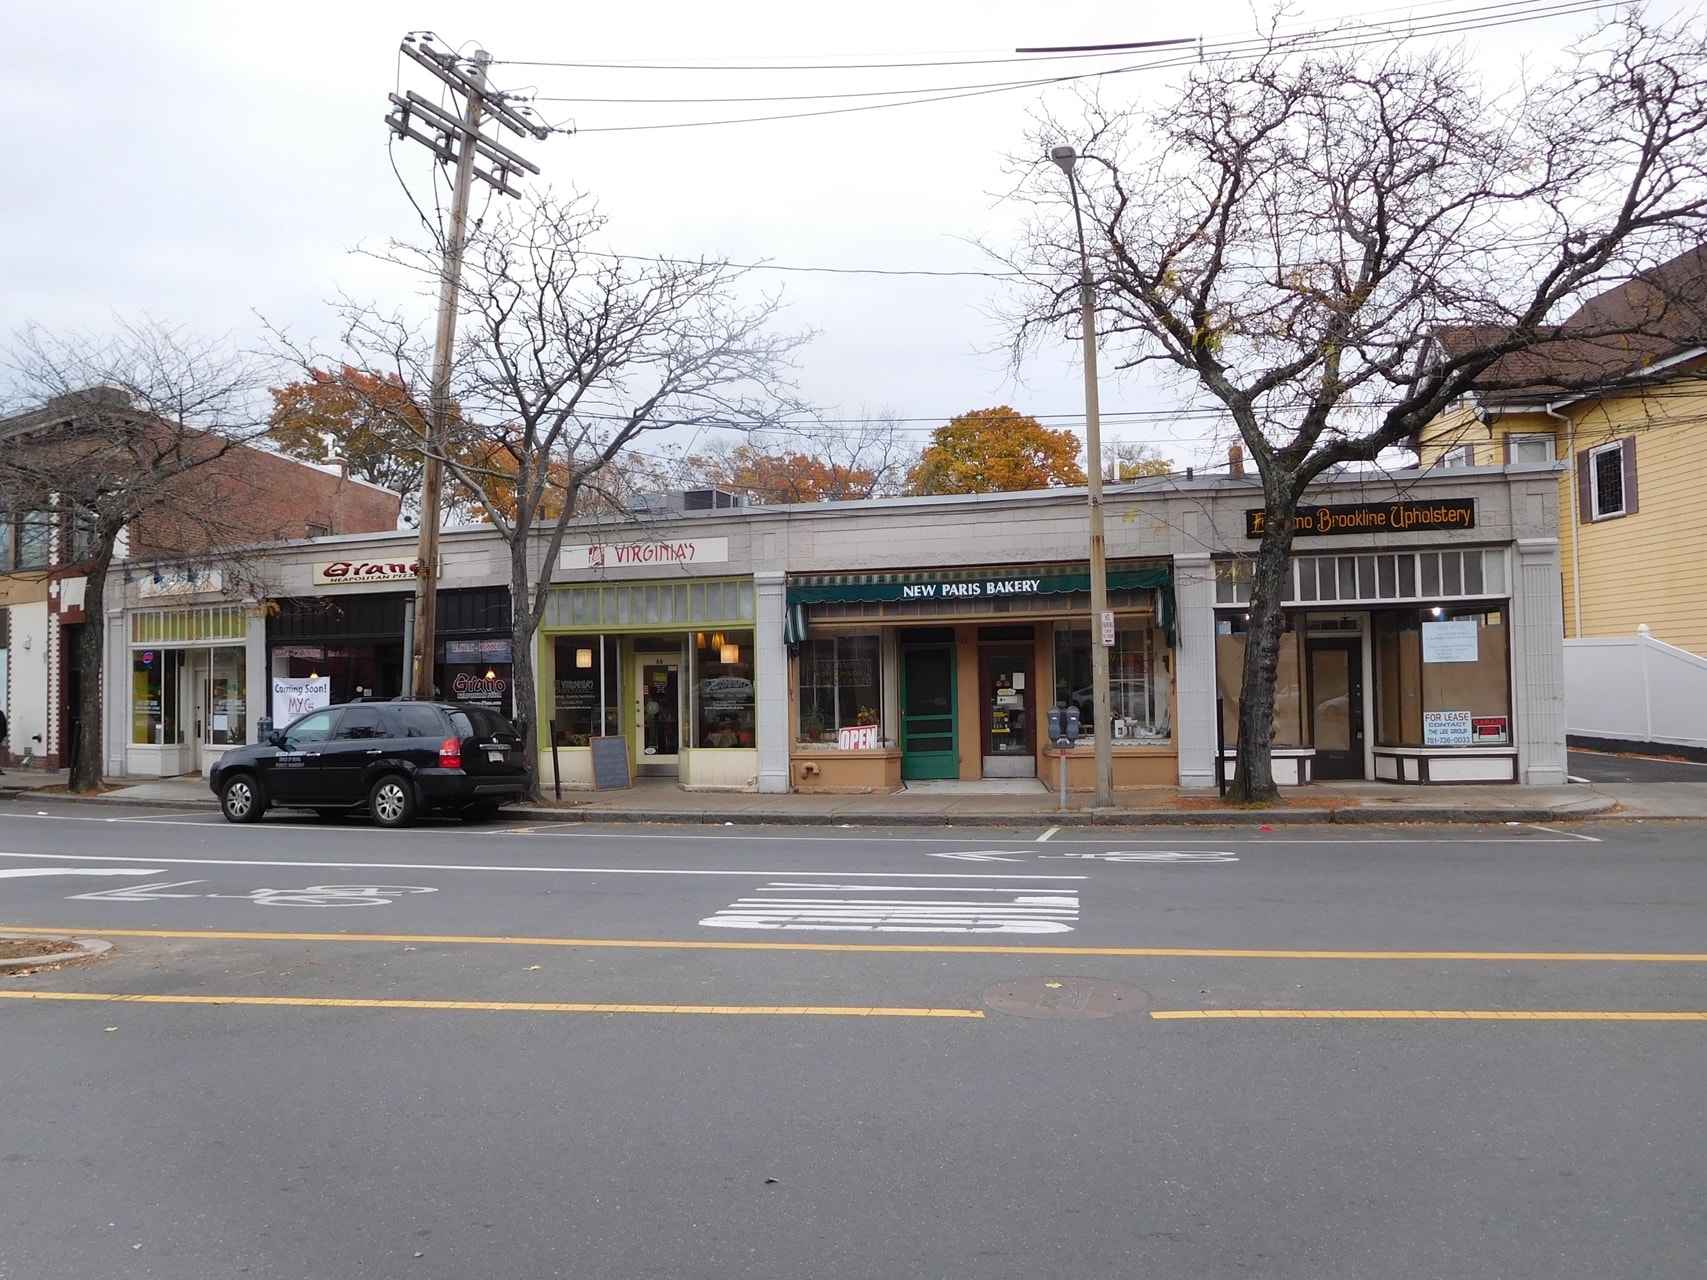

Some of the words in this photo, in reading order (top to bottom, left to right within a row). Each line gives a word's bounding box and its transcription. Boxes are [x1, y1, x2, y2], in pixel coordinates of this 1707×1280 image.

[1317, 508, 1386, 533] Brookline
[1390, 506, 1471, 528] Upholstery
[614, 542, 696, 563] VIRGINIA'S
[330, 574, 390, 583] NEAPOLITAN
[903, 584, 936, 597] NEW
[942, 583, 980, 595] PARIS
[986, 580, 1040, 594] BAKERY
[274, 683, 303, 696] Coming
[305, 683, 327, 694] Soon!
[453, 673, 506, 693] Grano
[1425, 714, 1441, 722] FOR
[1444, 713, 1469, 721] LEASE
[840, 729, 876, 750] OPEN
